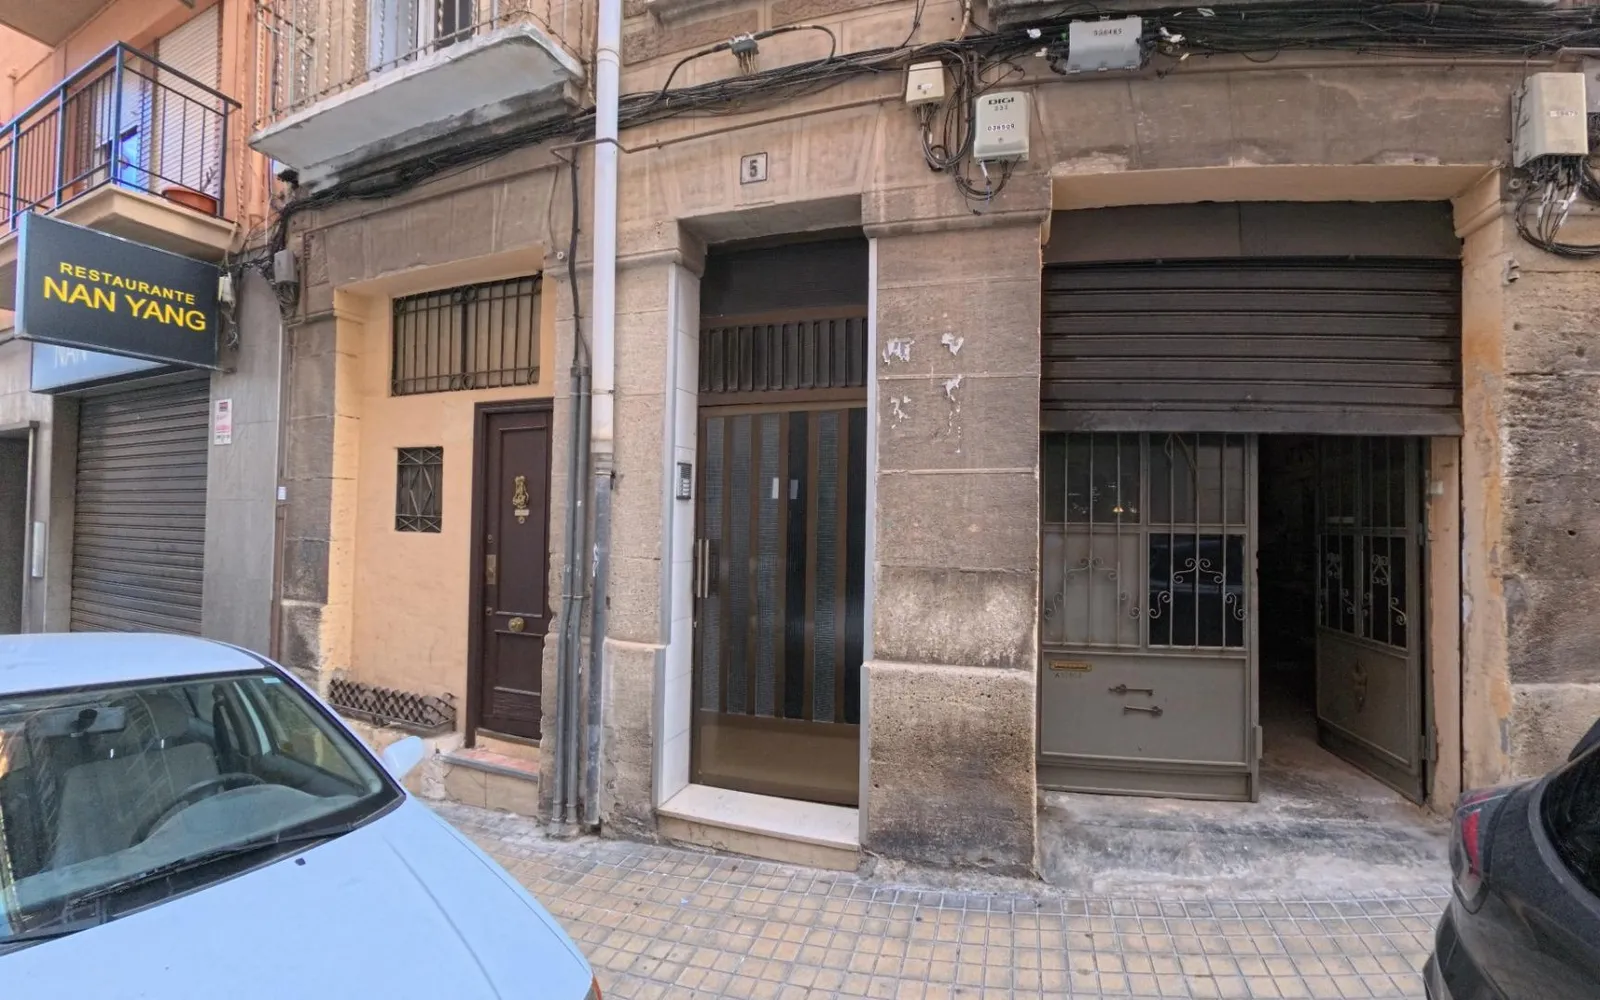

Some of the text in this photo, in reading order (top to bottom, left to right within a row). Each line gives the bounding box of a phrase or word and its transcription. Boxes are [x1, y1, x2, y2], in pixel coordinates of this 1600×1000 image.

[988, 97, 1014, 105] DIGI
[750, 160, 758, 178] 5
[59, 261, 196, 305] RESTAURANTE
[43, 275, 206, 331] NAN YANG
